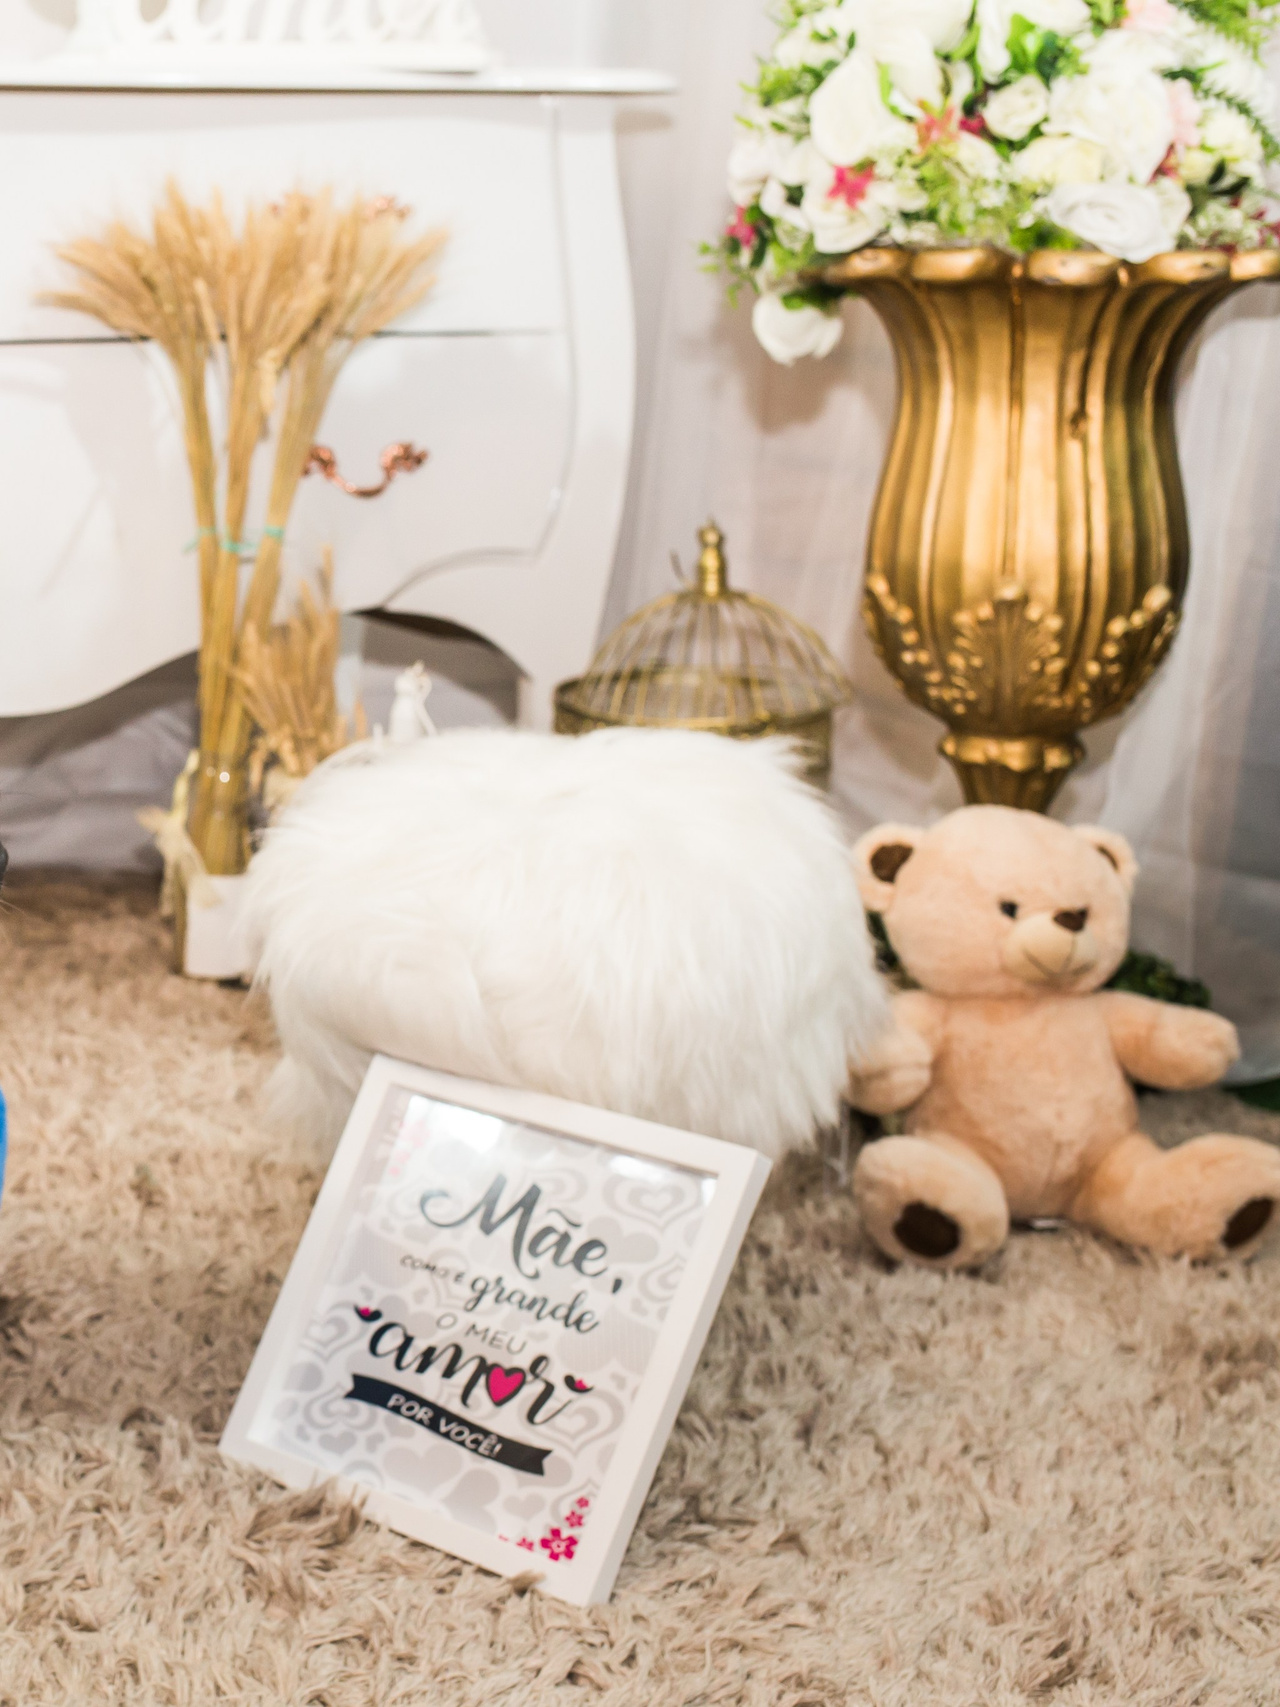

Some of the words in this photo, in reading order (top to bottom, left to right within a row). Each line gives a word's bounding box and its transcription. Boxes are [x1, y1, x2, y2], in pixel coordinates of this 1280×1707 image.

[419, 1173, 623, 1295] Mãe,
[436, 1312, 458, 1330] O
[465, 1323, 527, 1355] MEU
[465, 1275, 599, 1334] grande
[369, 1321, 573, 1425] amor
[386, 1393, 434, 1426] POR
[439, 1416, 503, 1458] VOCÊ!
